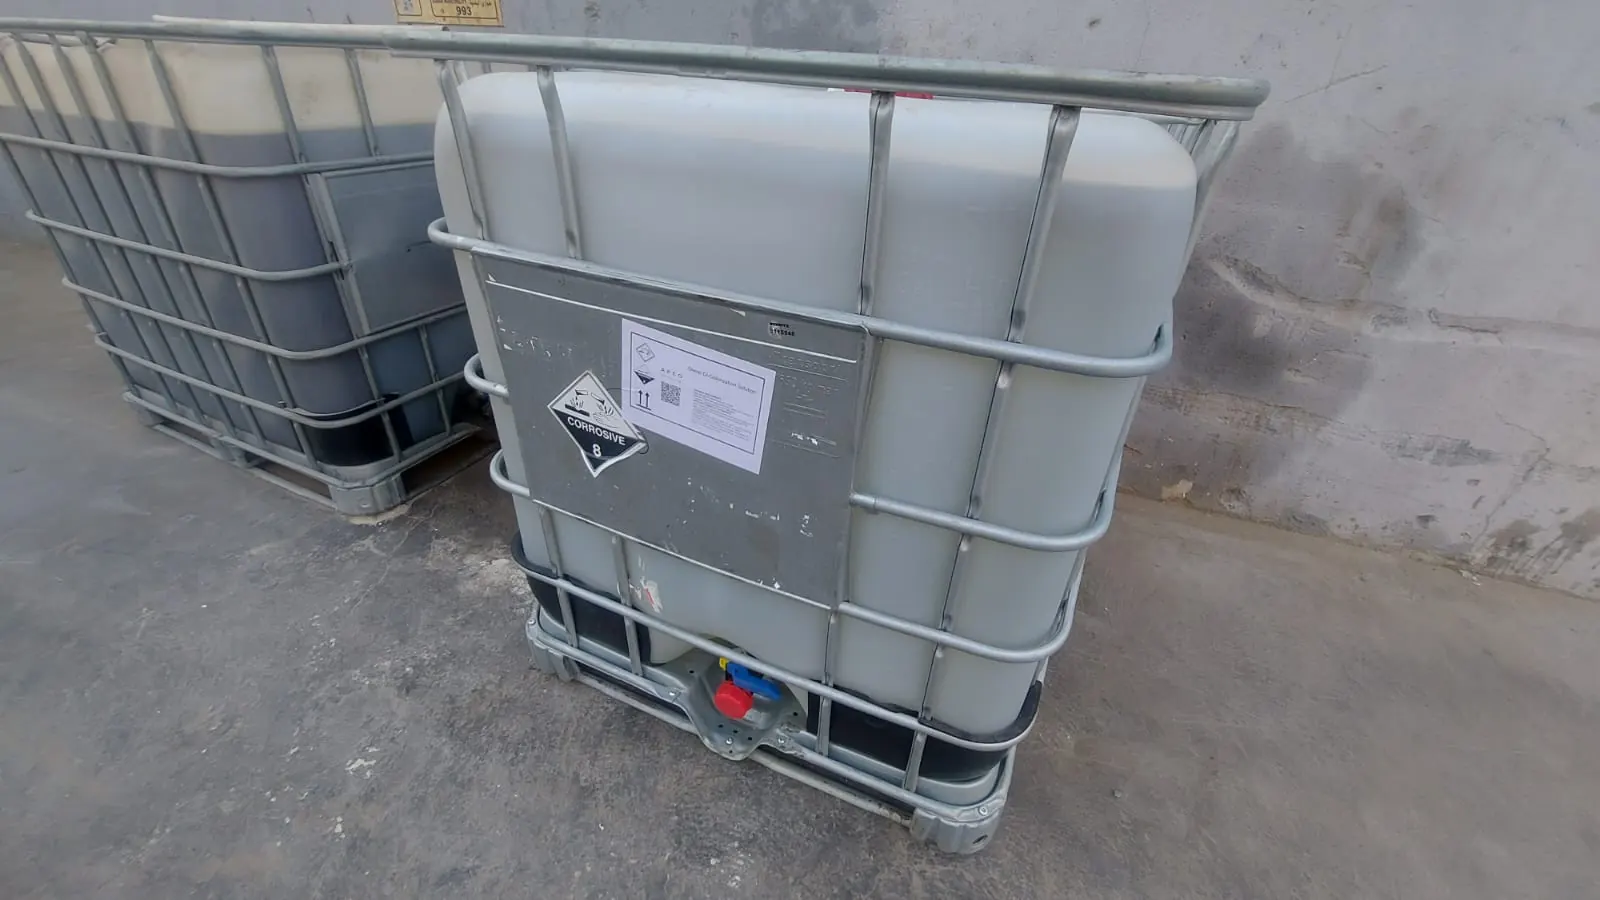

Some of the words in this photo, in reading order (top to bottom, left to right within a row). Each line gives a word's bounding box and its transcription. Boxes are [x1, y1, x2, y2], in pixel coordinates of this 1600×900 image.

[455, 6, 472, 16] 993
[567, 416, 626, 446] CORROSIVE
[592, 443, 602, 457] 8
